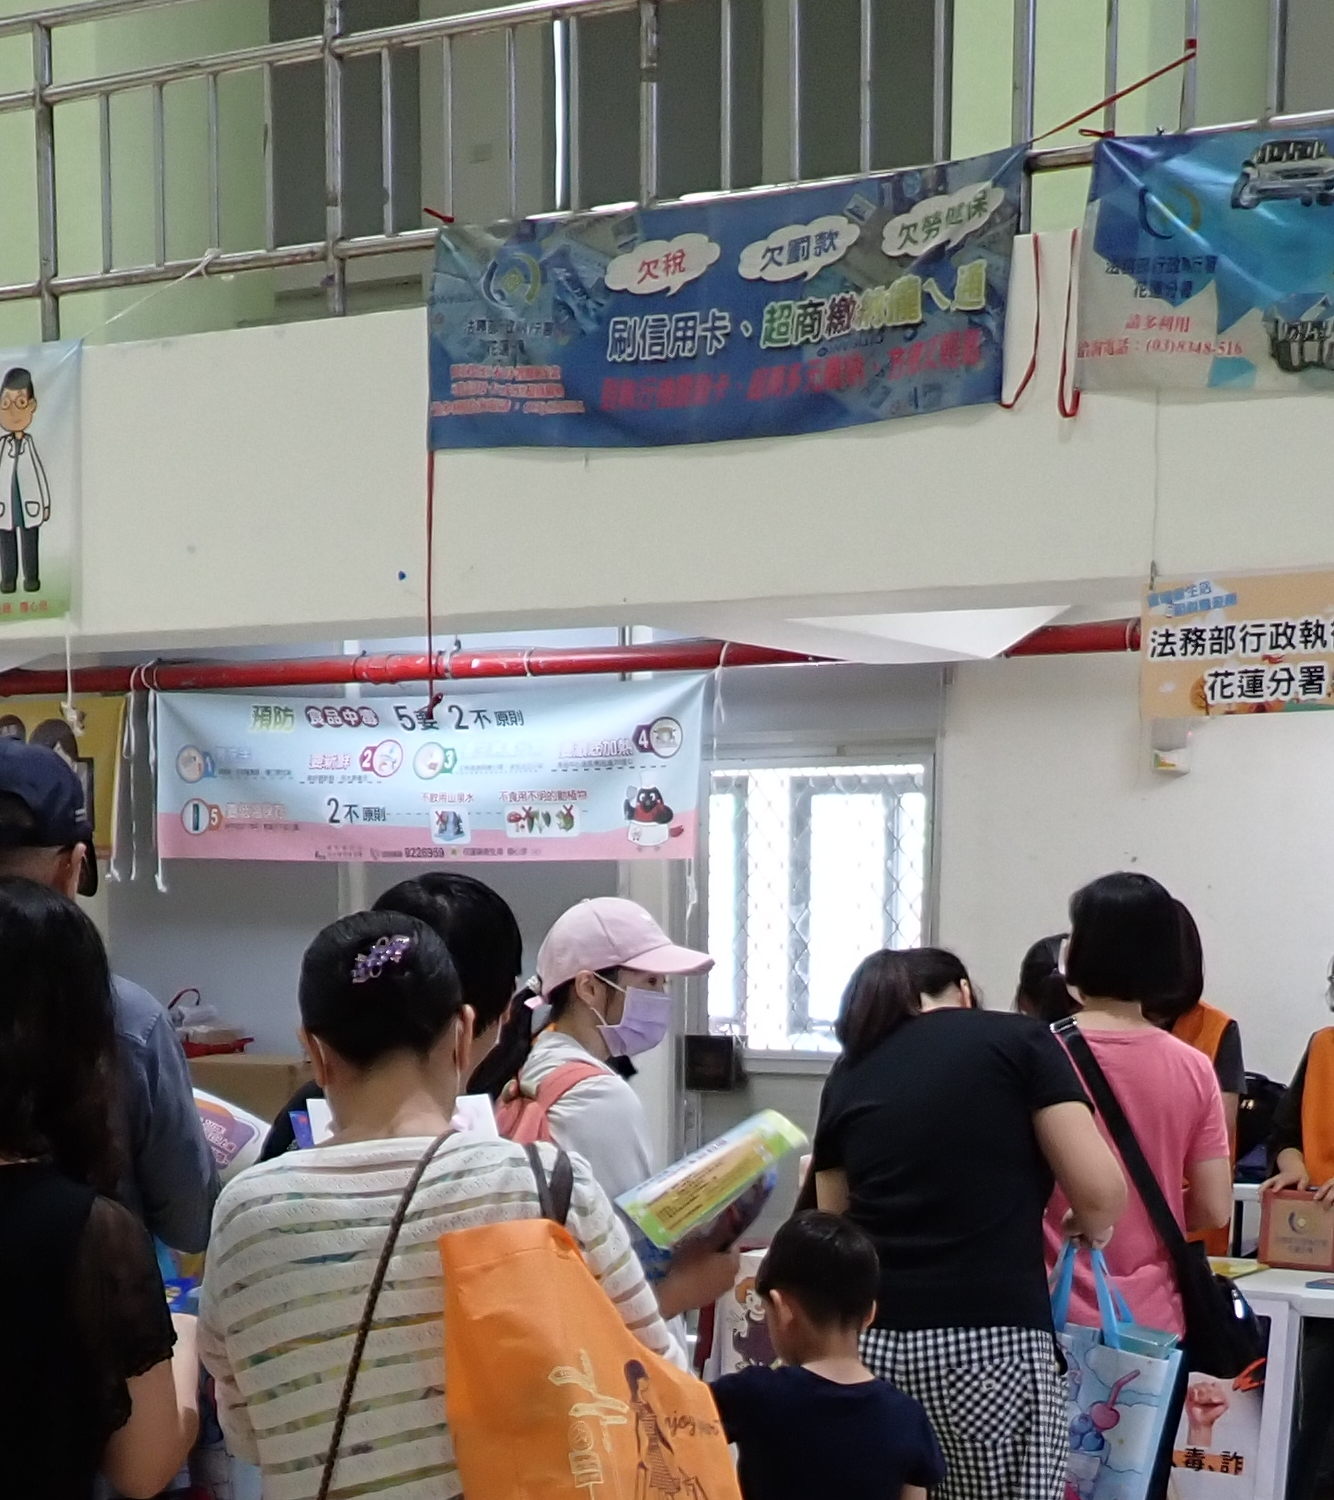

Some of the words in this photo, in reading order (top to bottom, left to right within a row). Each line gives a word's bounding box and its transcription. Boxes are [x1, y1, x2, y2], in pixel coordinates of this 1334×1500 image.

[637, 249, 687, 284] 欠稅
[759, 229, 840, 272] 欠罰款
[1207, 664, 1326, 701] 花蓮分署
[307, 706, 379, 728] 食品中毒
